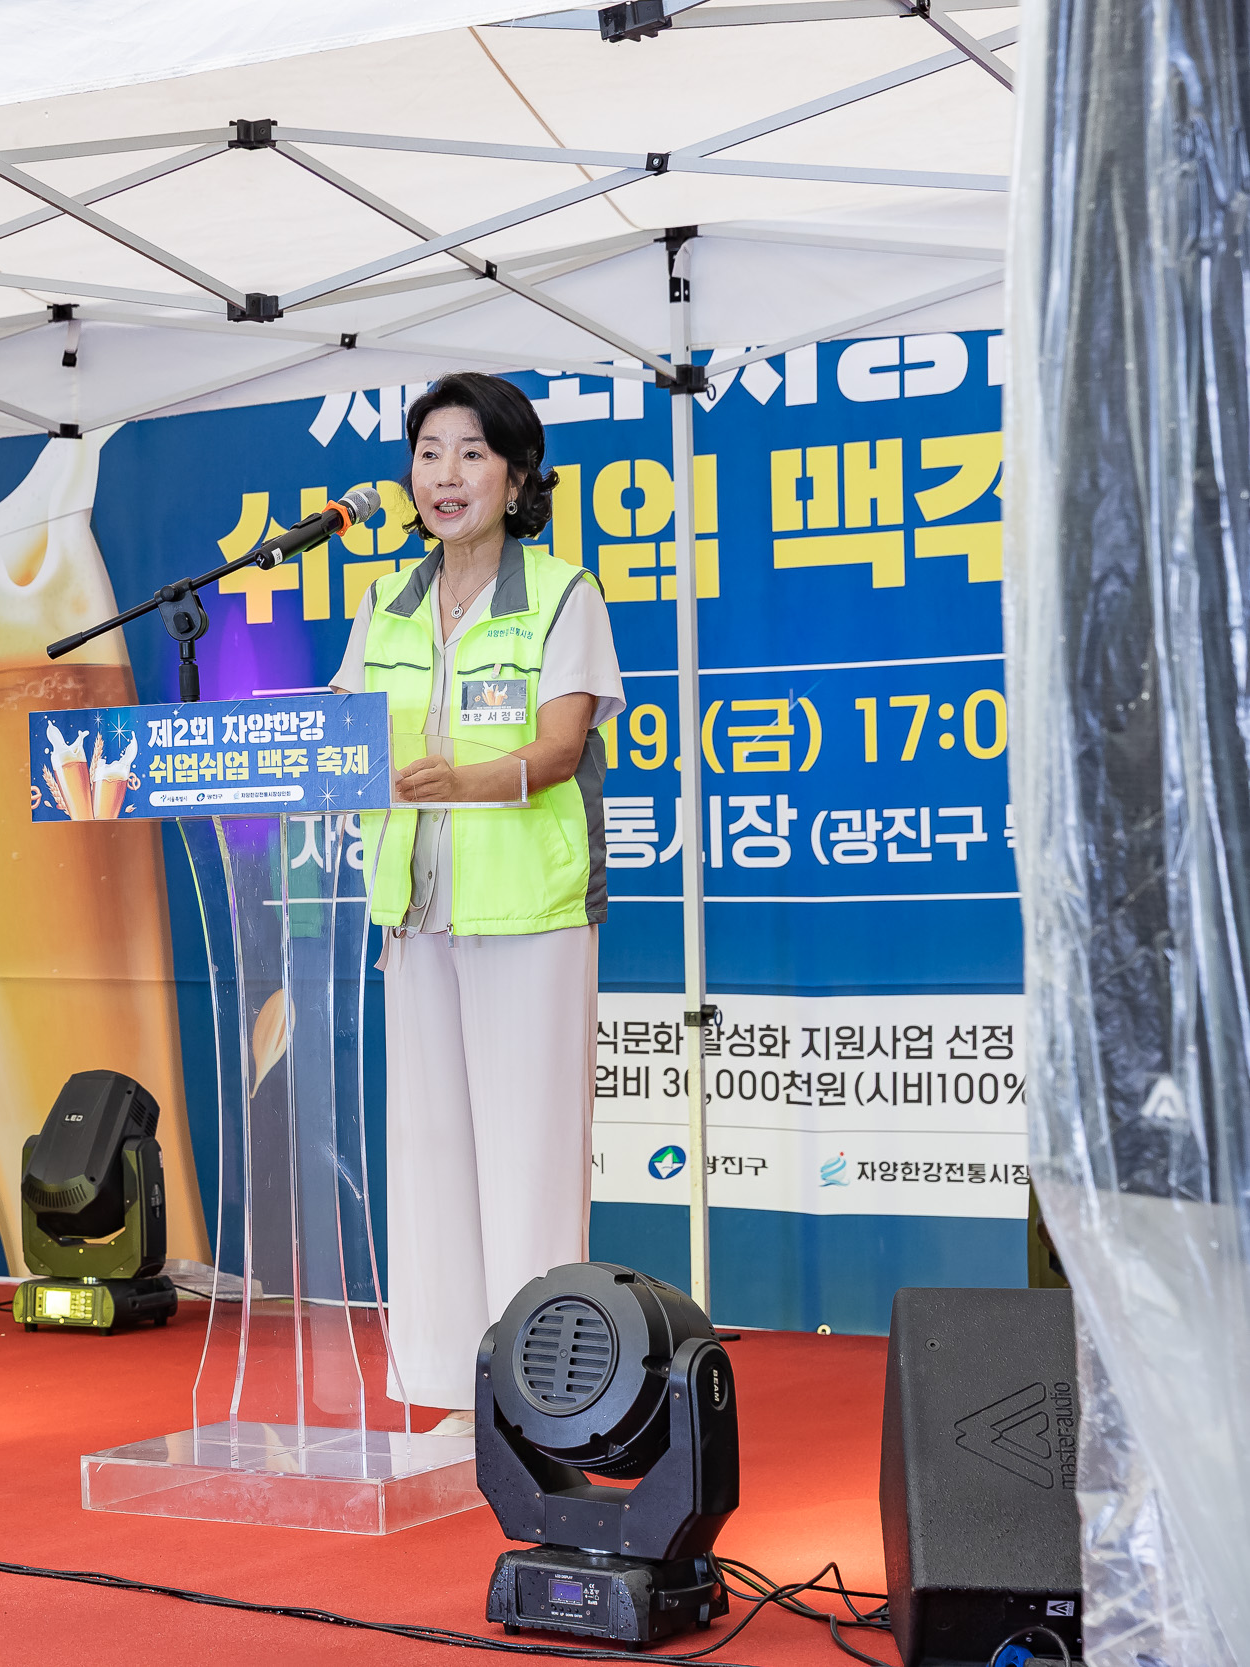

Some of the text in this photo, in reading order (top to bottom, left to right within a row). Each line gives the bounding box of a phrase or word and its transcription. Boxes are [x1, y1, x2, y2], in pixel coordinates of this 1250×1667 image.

[147, 710, 325, 747] 제2회 자양한강
[148, 744, 367, 783] 쉬엄쉬엄 맥주 축제
[801, 1025, 934, 1060] 지원사업
[945, 1025, 1014, 1060] 선정
[594, 1065, 650, 1100] 업비
[1050, 1381, 1078, 1490] master-audio
